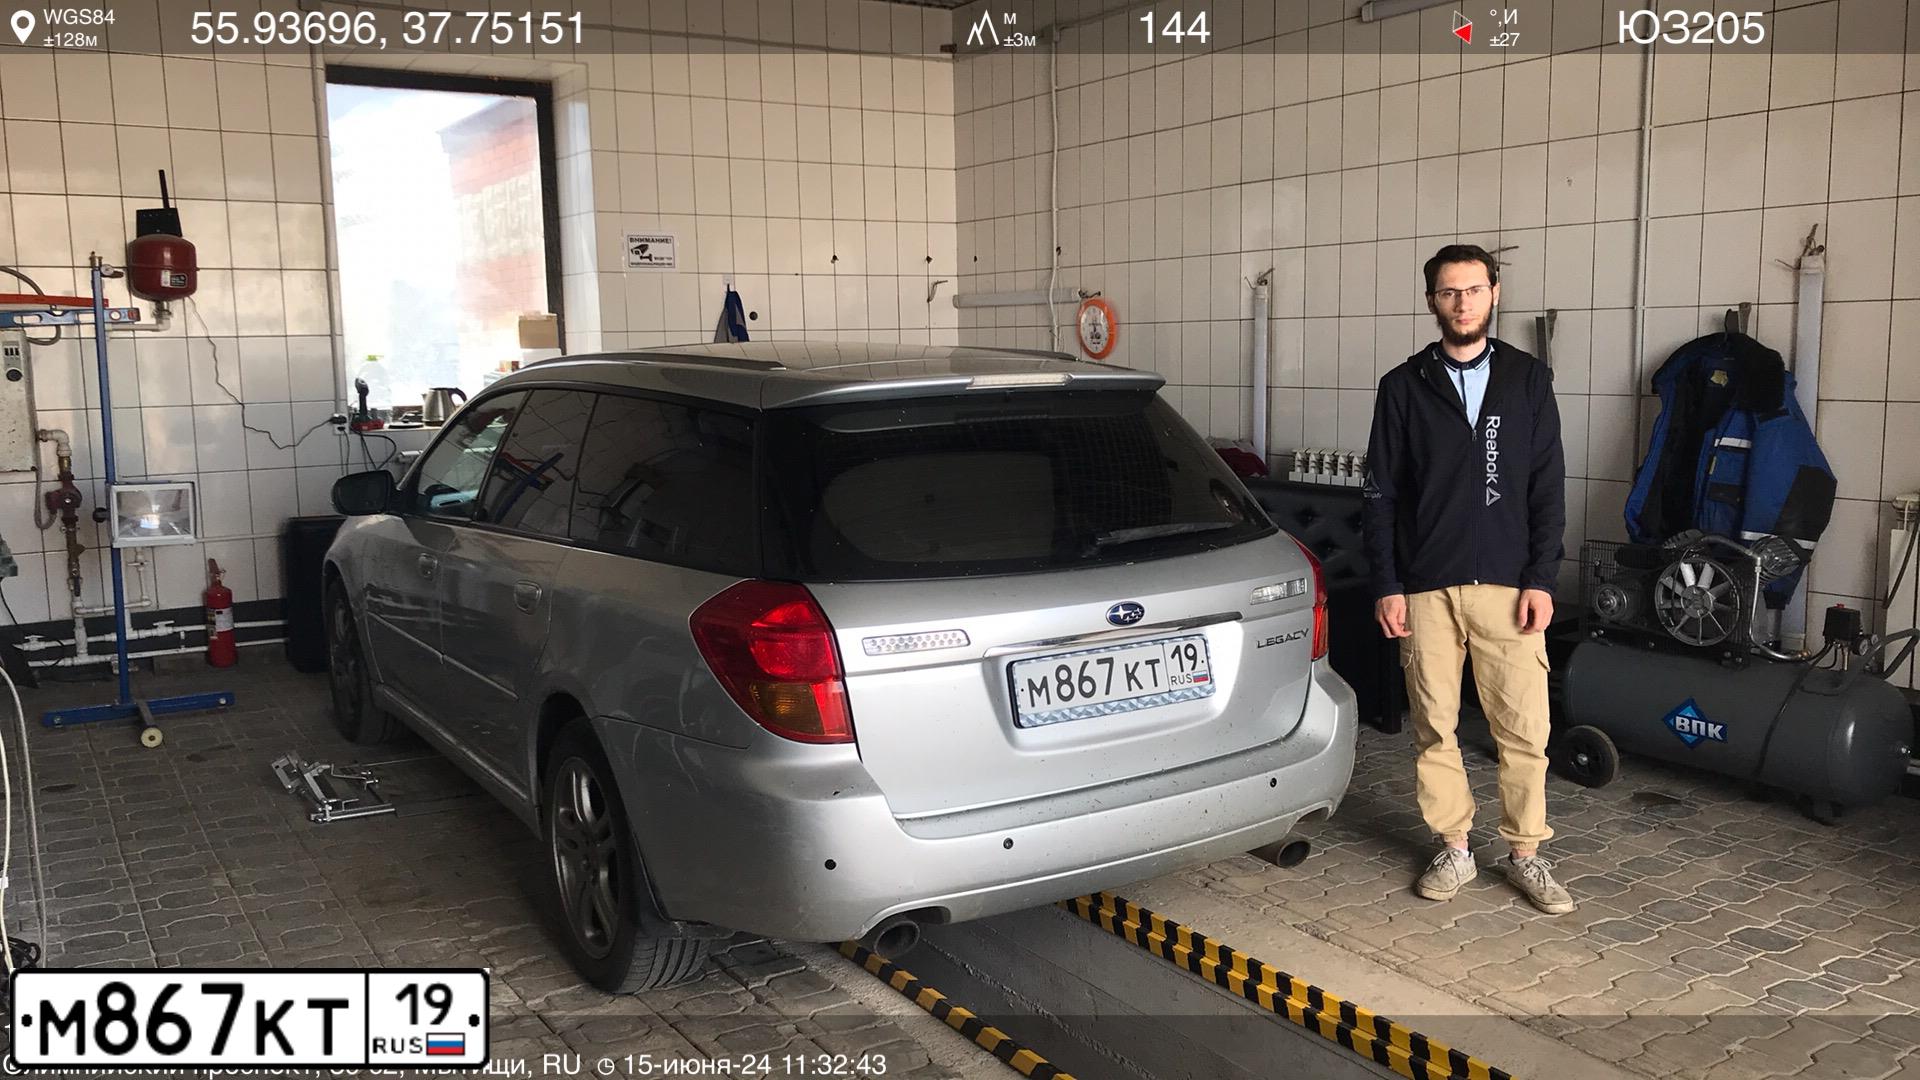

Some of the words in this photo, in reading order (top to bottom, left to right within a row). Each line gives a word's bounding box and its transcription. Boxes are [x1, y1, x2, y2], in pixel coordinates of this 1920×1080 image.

[1485, 415, 1501, 485] Reebok
[1256, 628, 1309, 649] LEGACY
[1170, 643, 1198, 673] 19
[1170, 674, 1193, 686] RUS
[1675, 715, 1724, 740] ВПК
